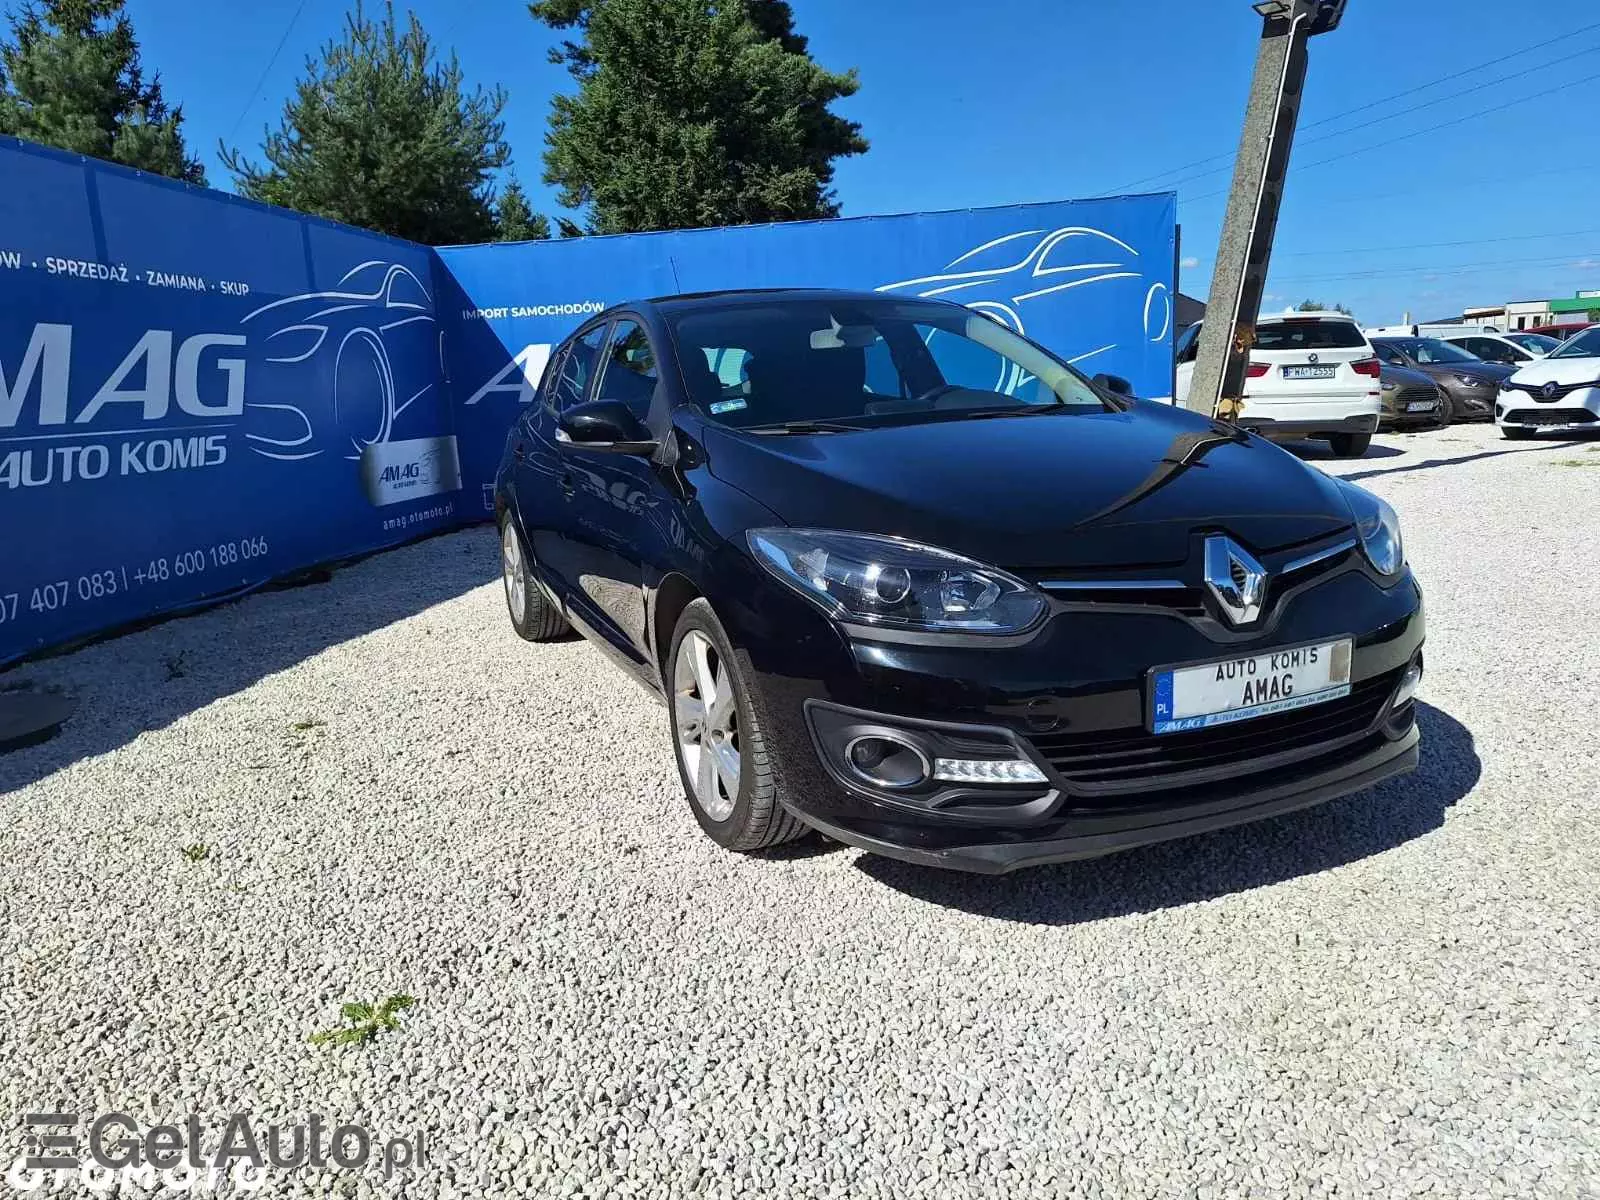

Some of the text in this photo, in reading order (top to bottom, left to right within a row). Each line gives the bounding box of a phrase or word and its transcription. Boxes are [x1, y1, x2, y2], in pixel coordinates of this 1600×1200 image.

[0, 251, 249, 296] W SPRZEDAŻ ZAMIANA SKUP
[462, 301, 605, 321] IMPORT SAMOCHODÓW
[0, 434, 227, 489] AUTO KOMIS
[379, 462, 420, 482] AMAG
[383, 501, 454, 530] amag.otomoto.pl
[30, 581, 69, 613] 407
[77, 570, 118, 601] 083
[134, 558, 169, 586] +48
[175, 550, 205, 577] 600
[210, 542, 238, 567] 188
[241, 535, 268, 560] 066
[1215, 647, 1318, 682] AUTO KOMIS
[1242, 673, 1293, 706] AMAG
[1157, 703, 1169, 715] PL
